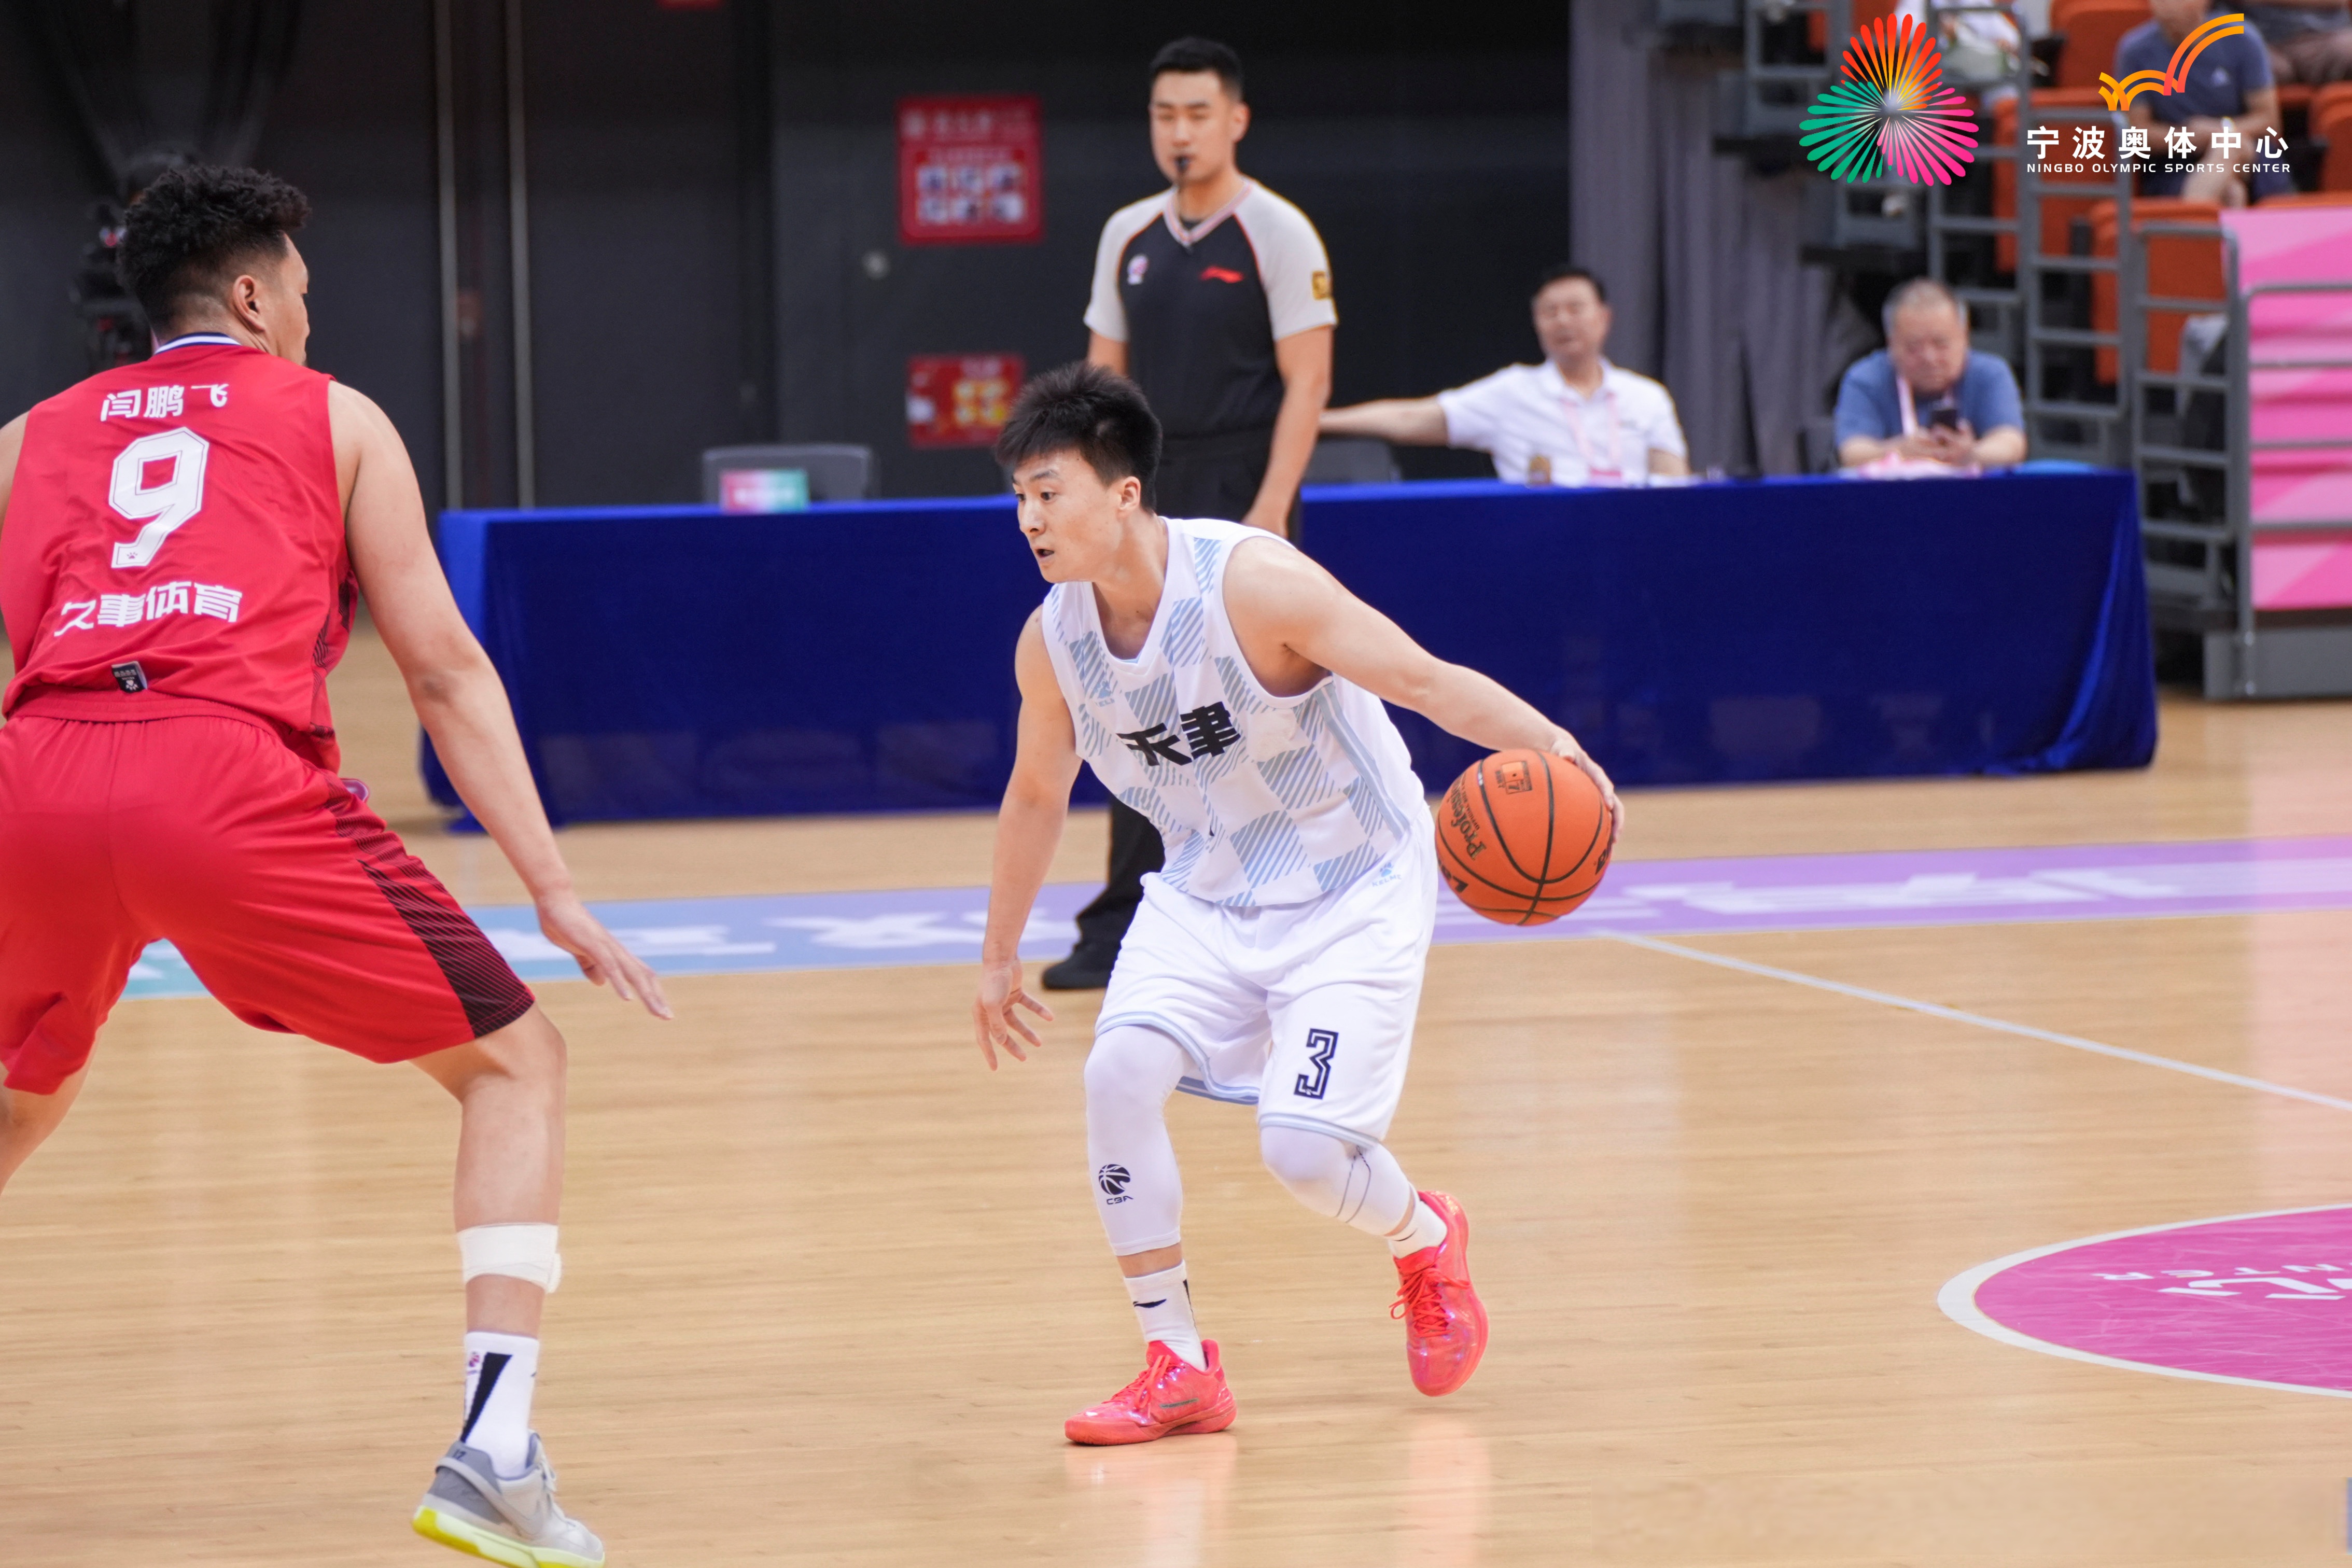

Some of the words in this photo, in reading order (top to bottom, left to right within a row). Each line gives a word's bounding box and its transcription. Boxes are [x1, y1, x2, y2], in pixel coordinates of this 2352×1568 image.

[100, 383, 229, 422] 闫鹏飞
[108, 427, 209, 569] 9
[53, 581, 243, 637] 久事体育
[1293, 1028, 1339, 1100] 3
[1107, 1195, 1134, 1205] CBA
[2090, 1263, 2352, 1280] NTER
